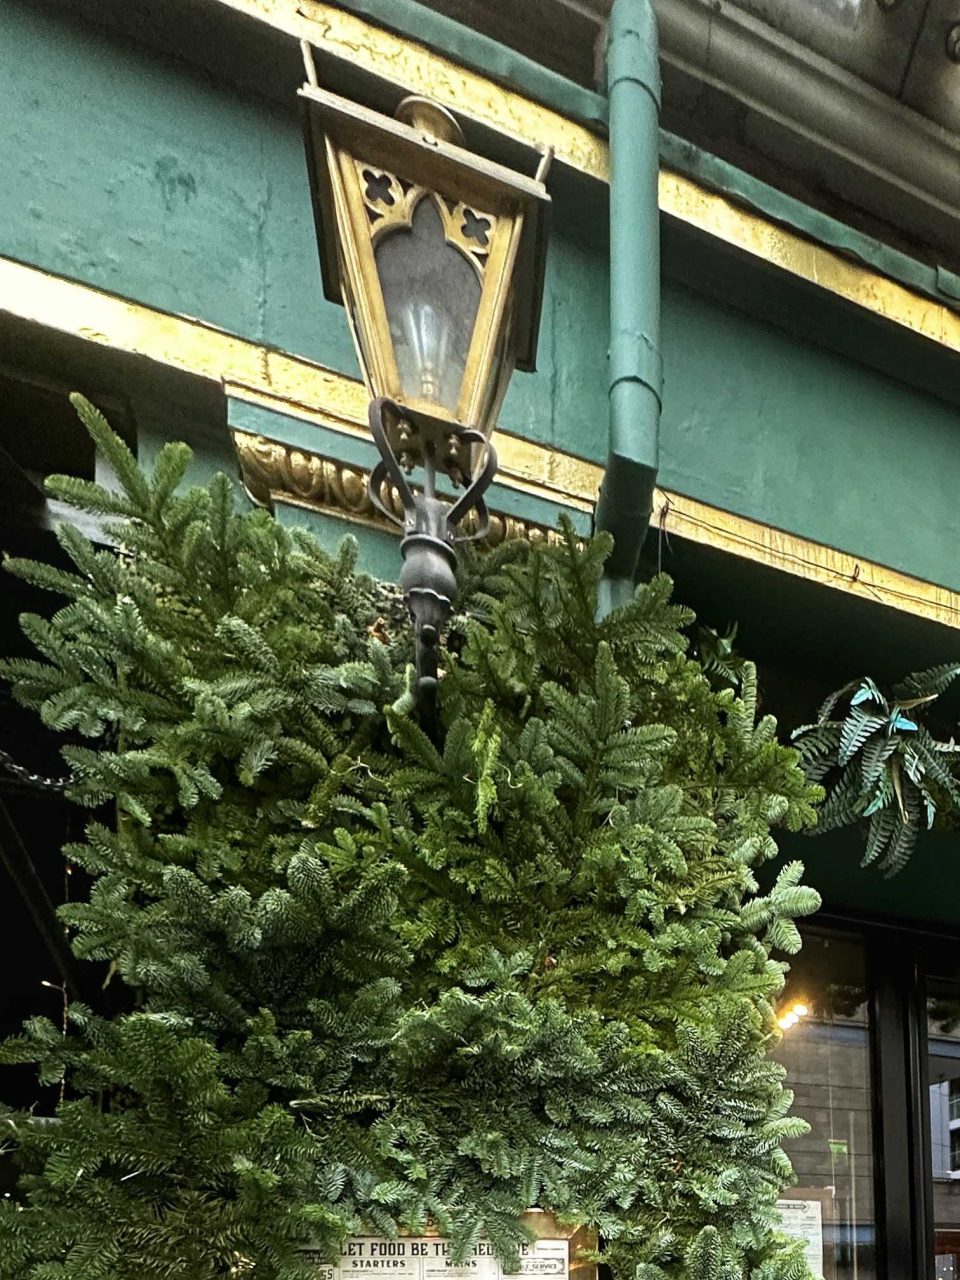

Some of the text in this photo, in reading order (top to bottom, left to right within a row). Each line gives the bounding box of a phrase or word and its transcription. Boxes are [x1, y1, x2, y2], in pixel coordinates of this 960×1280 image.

[370, 1242, 406, 1256] FOOD
[411, 1242, 428, 1256] BE
[352, 1259, 406, 1268] STARTERS
